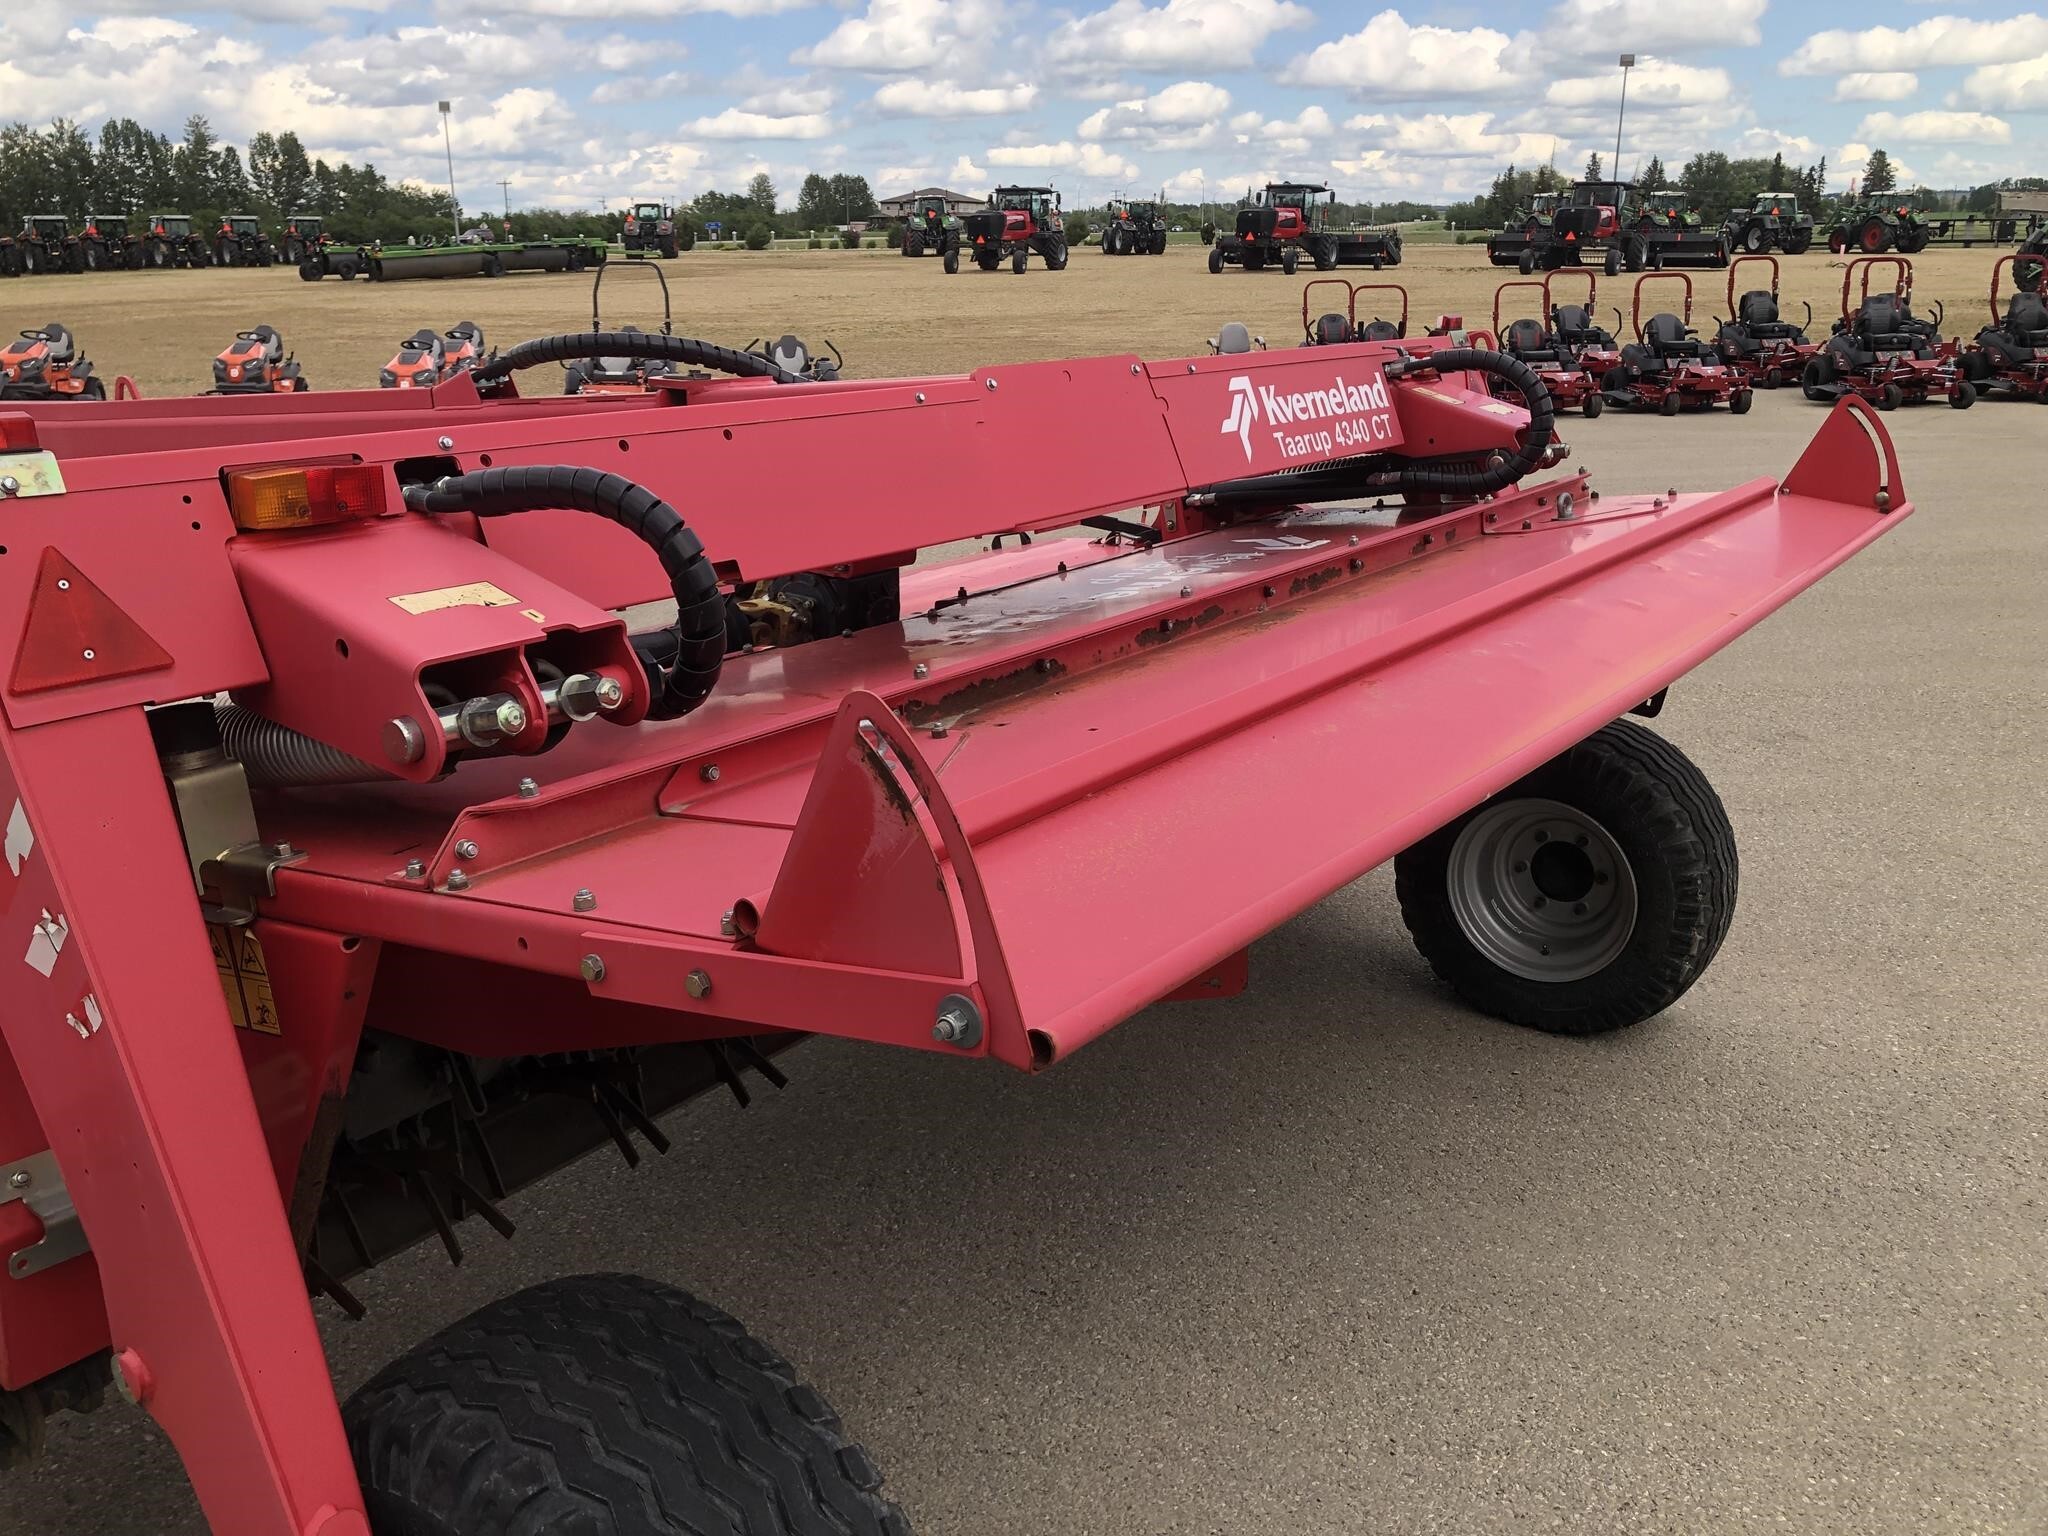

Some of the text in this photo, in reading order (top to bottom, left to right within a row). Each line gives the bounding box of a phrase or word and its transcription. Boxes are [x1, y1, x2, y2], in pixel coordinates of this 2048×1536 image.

[1258, 372, 1389, 426] Kverneland
[1273, 413, 1392, 459] Taarup 4340 CT
